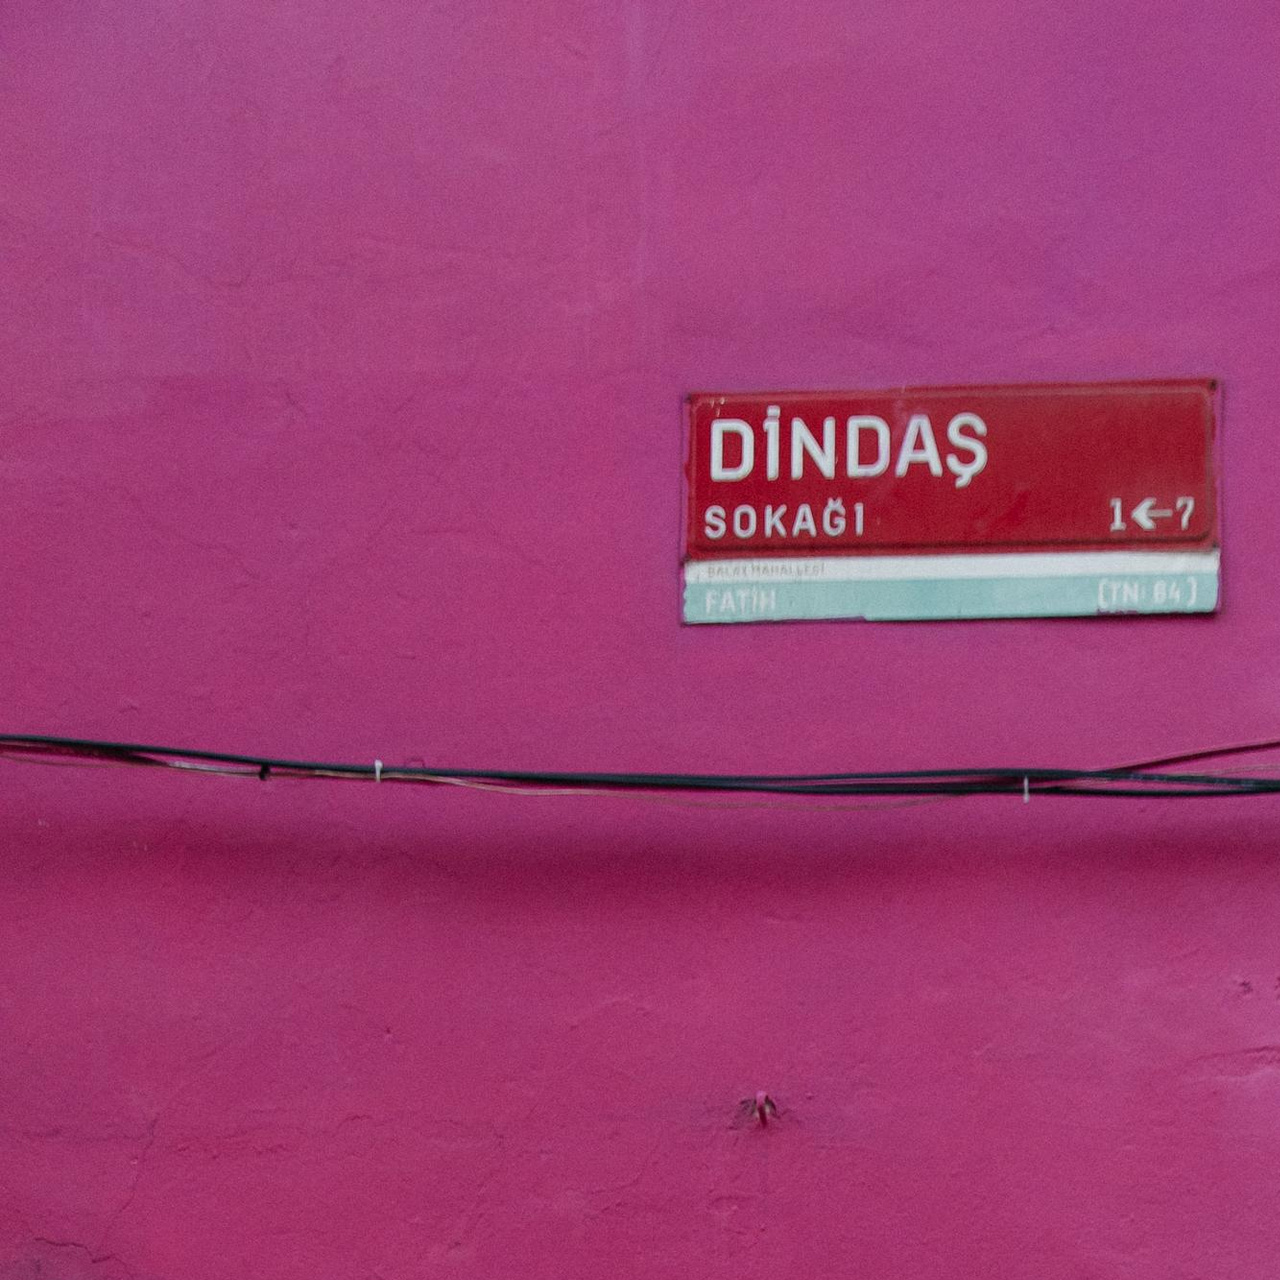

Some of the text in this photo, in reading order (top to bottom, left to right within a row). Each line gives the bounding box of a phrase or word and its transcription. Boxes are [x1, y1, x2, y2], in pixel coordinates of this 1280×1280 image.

[710, 405, 988, 488] DİNDAŞ
[704, 498, 864, 538] SOKAĞI
[705, 585, 776, 614] FATİH
